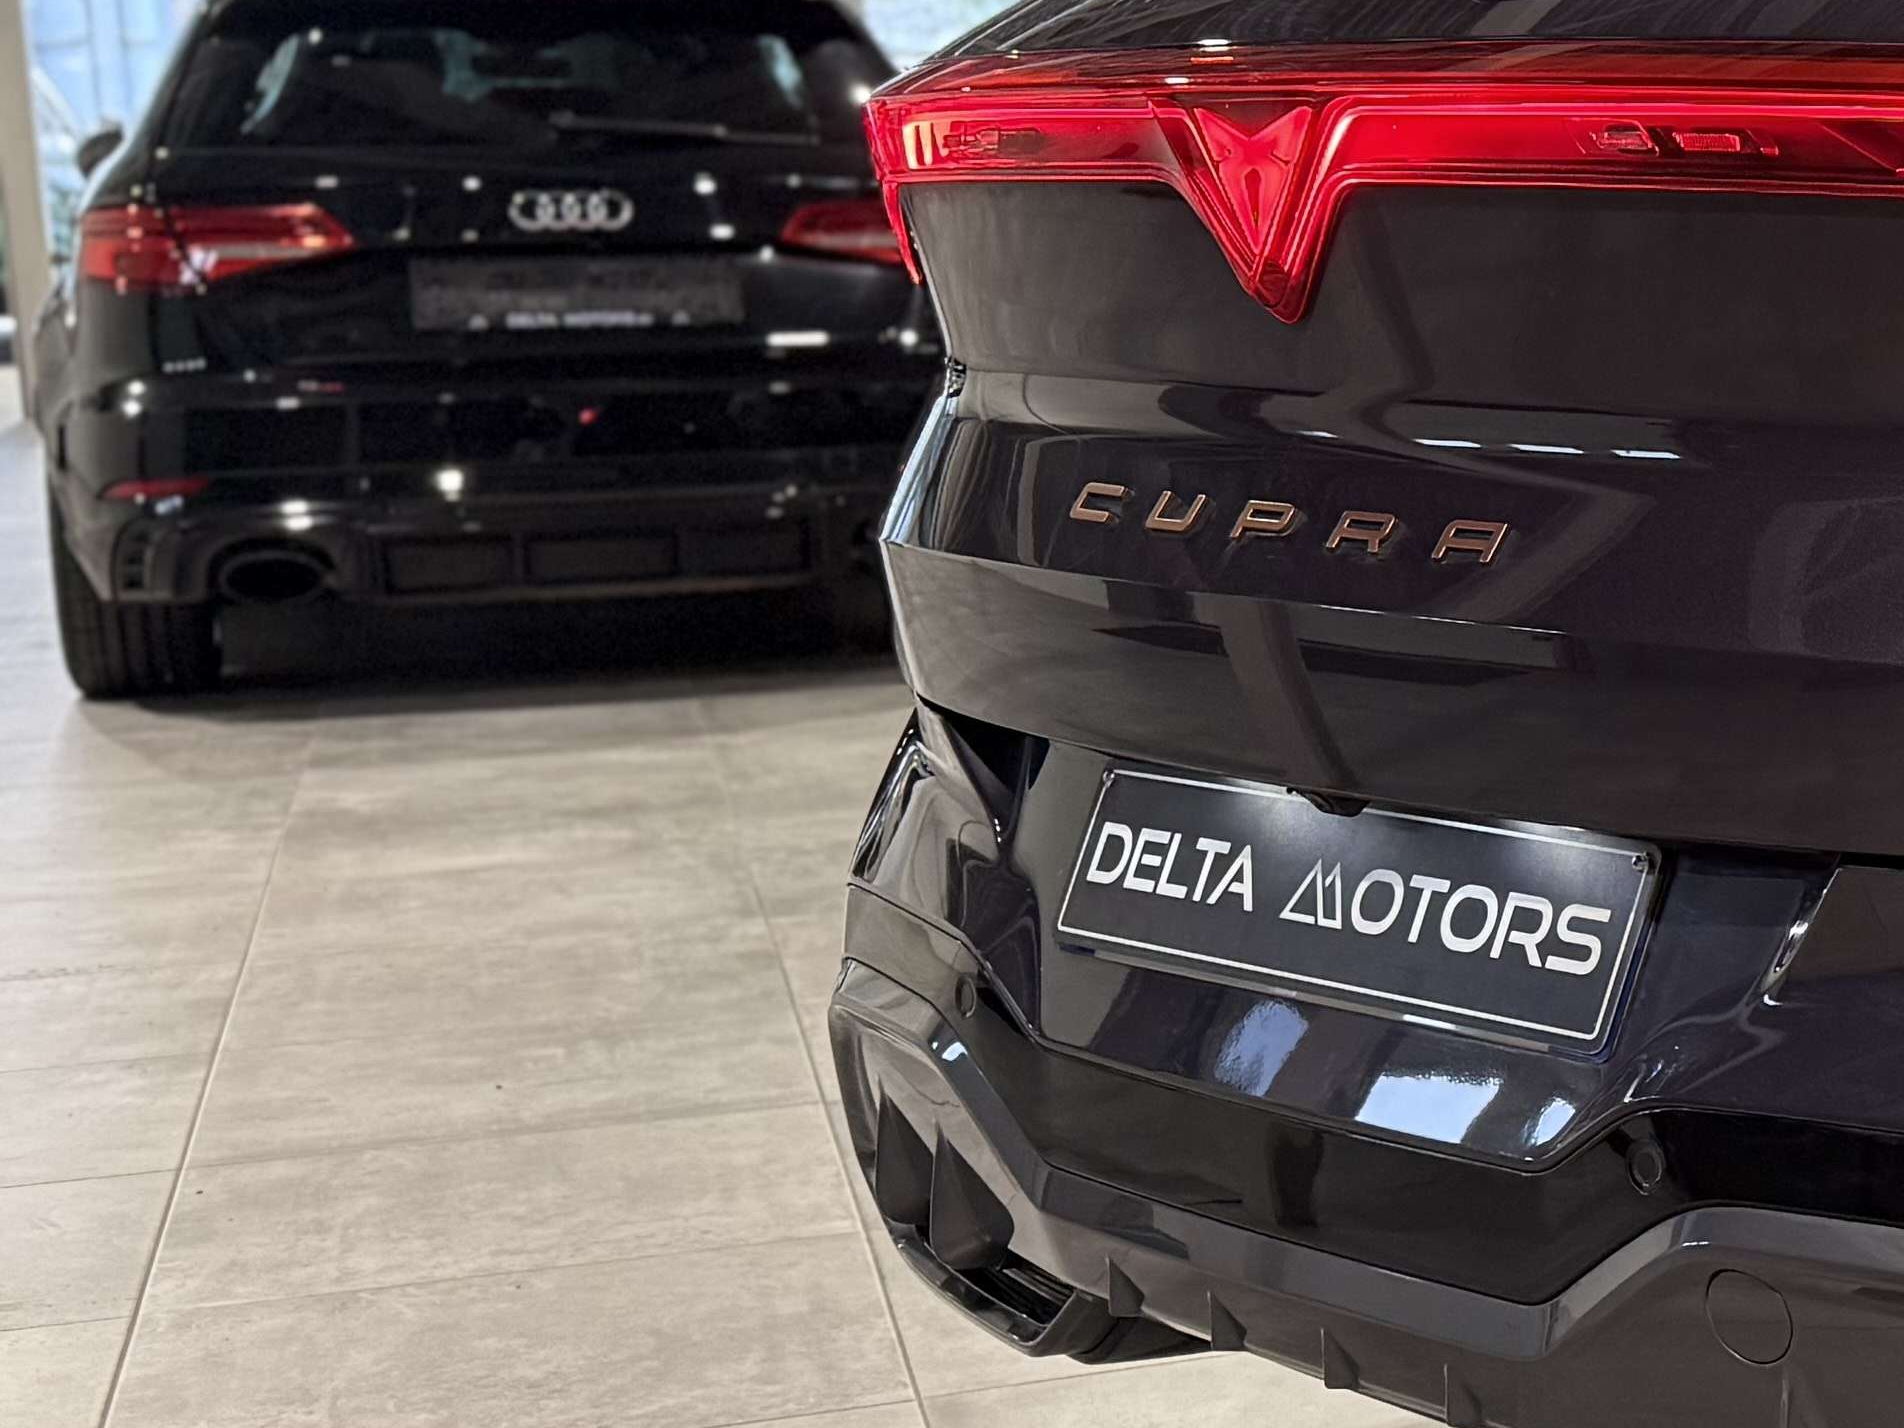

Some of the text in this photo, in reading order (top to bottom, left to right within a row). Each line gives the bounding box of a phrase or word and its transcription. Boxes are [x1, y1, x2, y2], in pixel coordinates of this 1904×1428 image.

[1069, 482, 1508, 564] CUPRA
[1086, 821, 1611, 976] DELTA MOTORS
